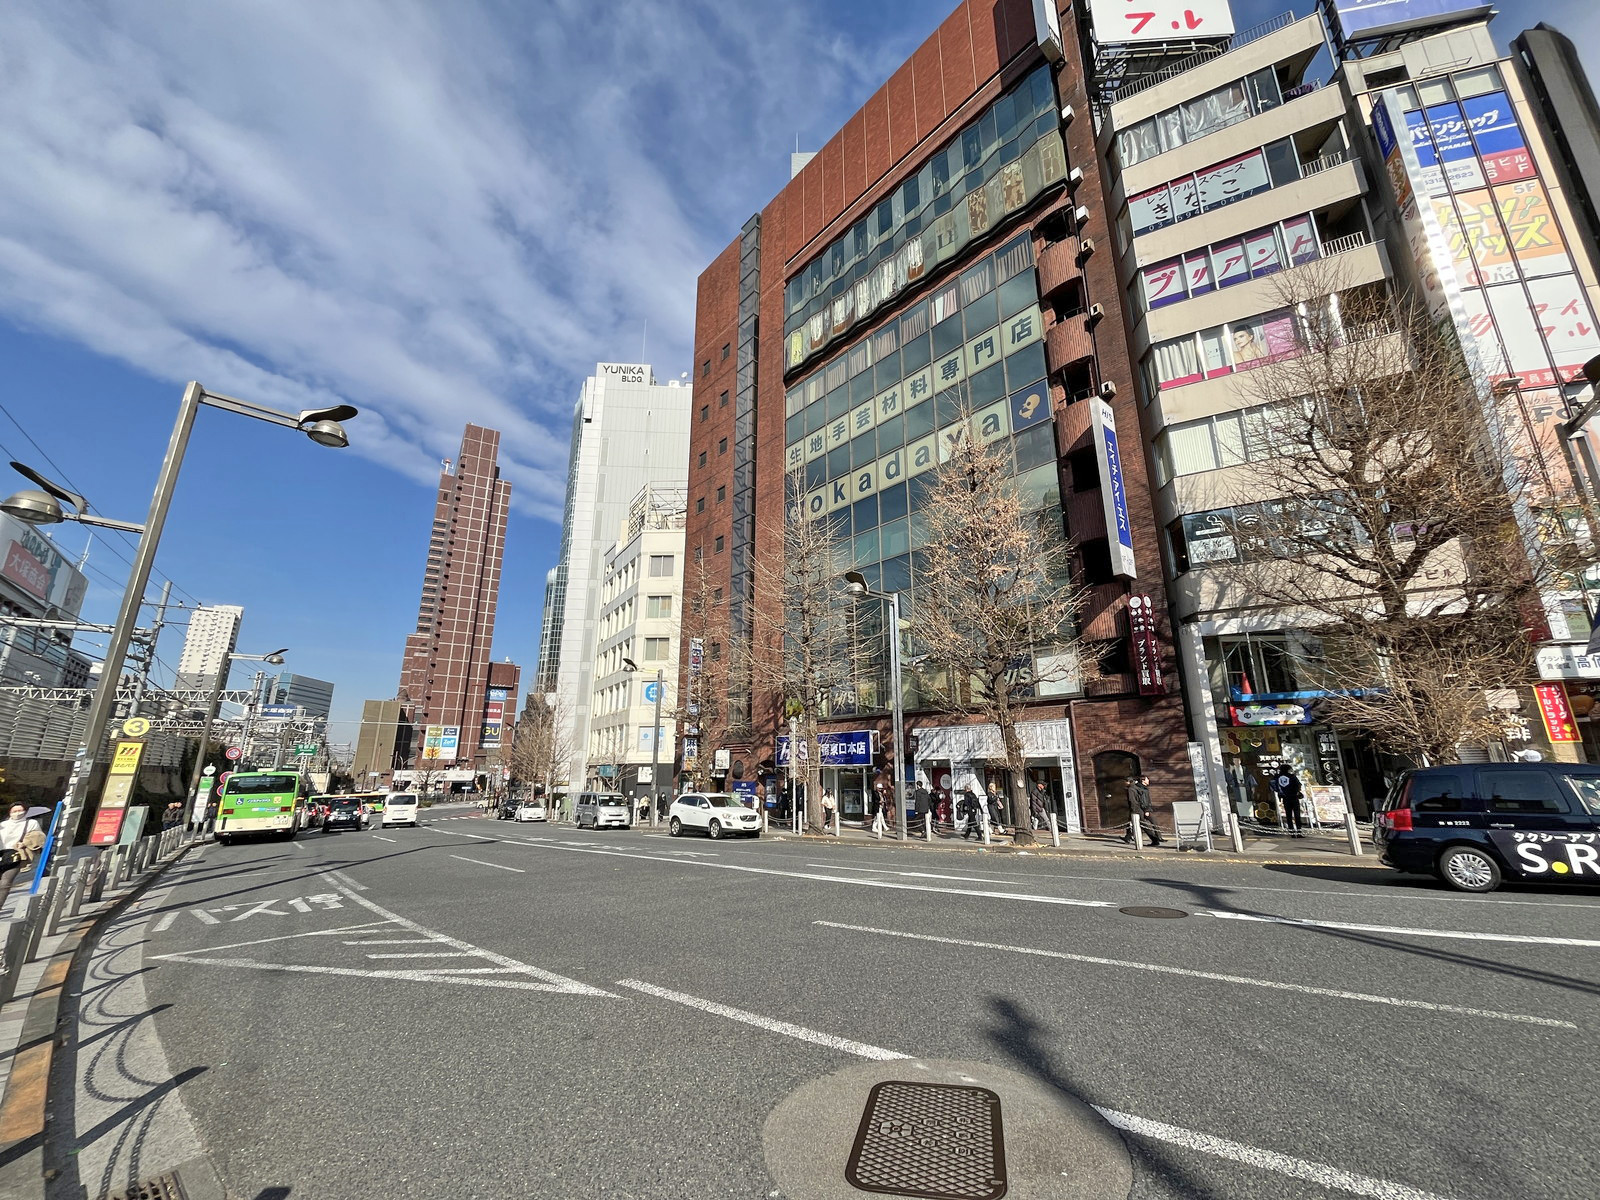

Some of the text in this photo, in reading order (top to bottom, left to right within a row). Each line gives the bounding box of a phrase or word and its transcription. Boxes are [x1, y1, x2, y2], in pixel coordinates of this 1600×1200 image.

[1147, 163, 1246, 205] レンタルスペース
[1513, 181, 1536, 194] 5F
[1152, 178, 1241, 220] きなこ
[1149, 235, 1313, 299] ブリアント
[603, 365, 644, 375] YUNIKA
[810, 411, 1001, 513] okadaya
[129, 720, 144, 733] 3
[483, 727, 499, 736] GU
[1513, 832, 1600, 843] タクシーアプ
